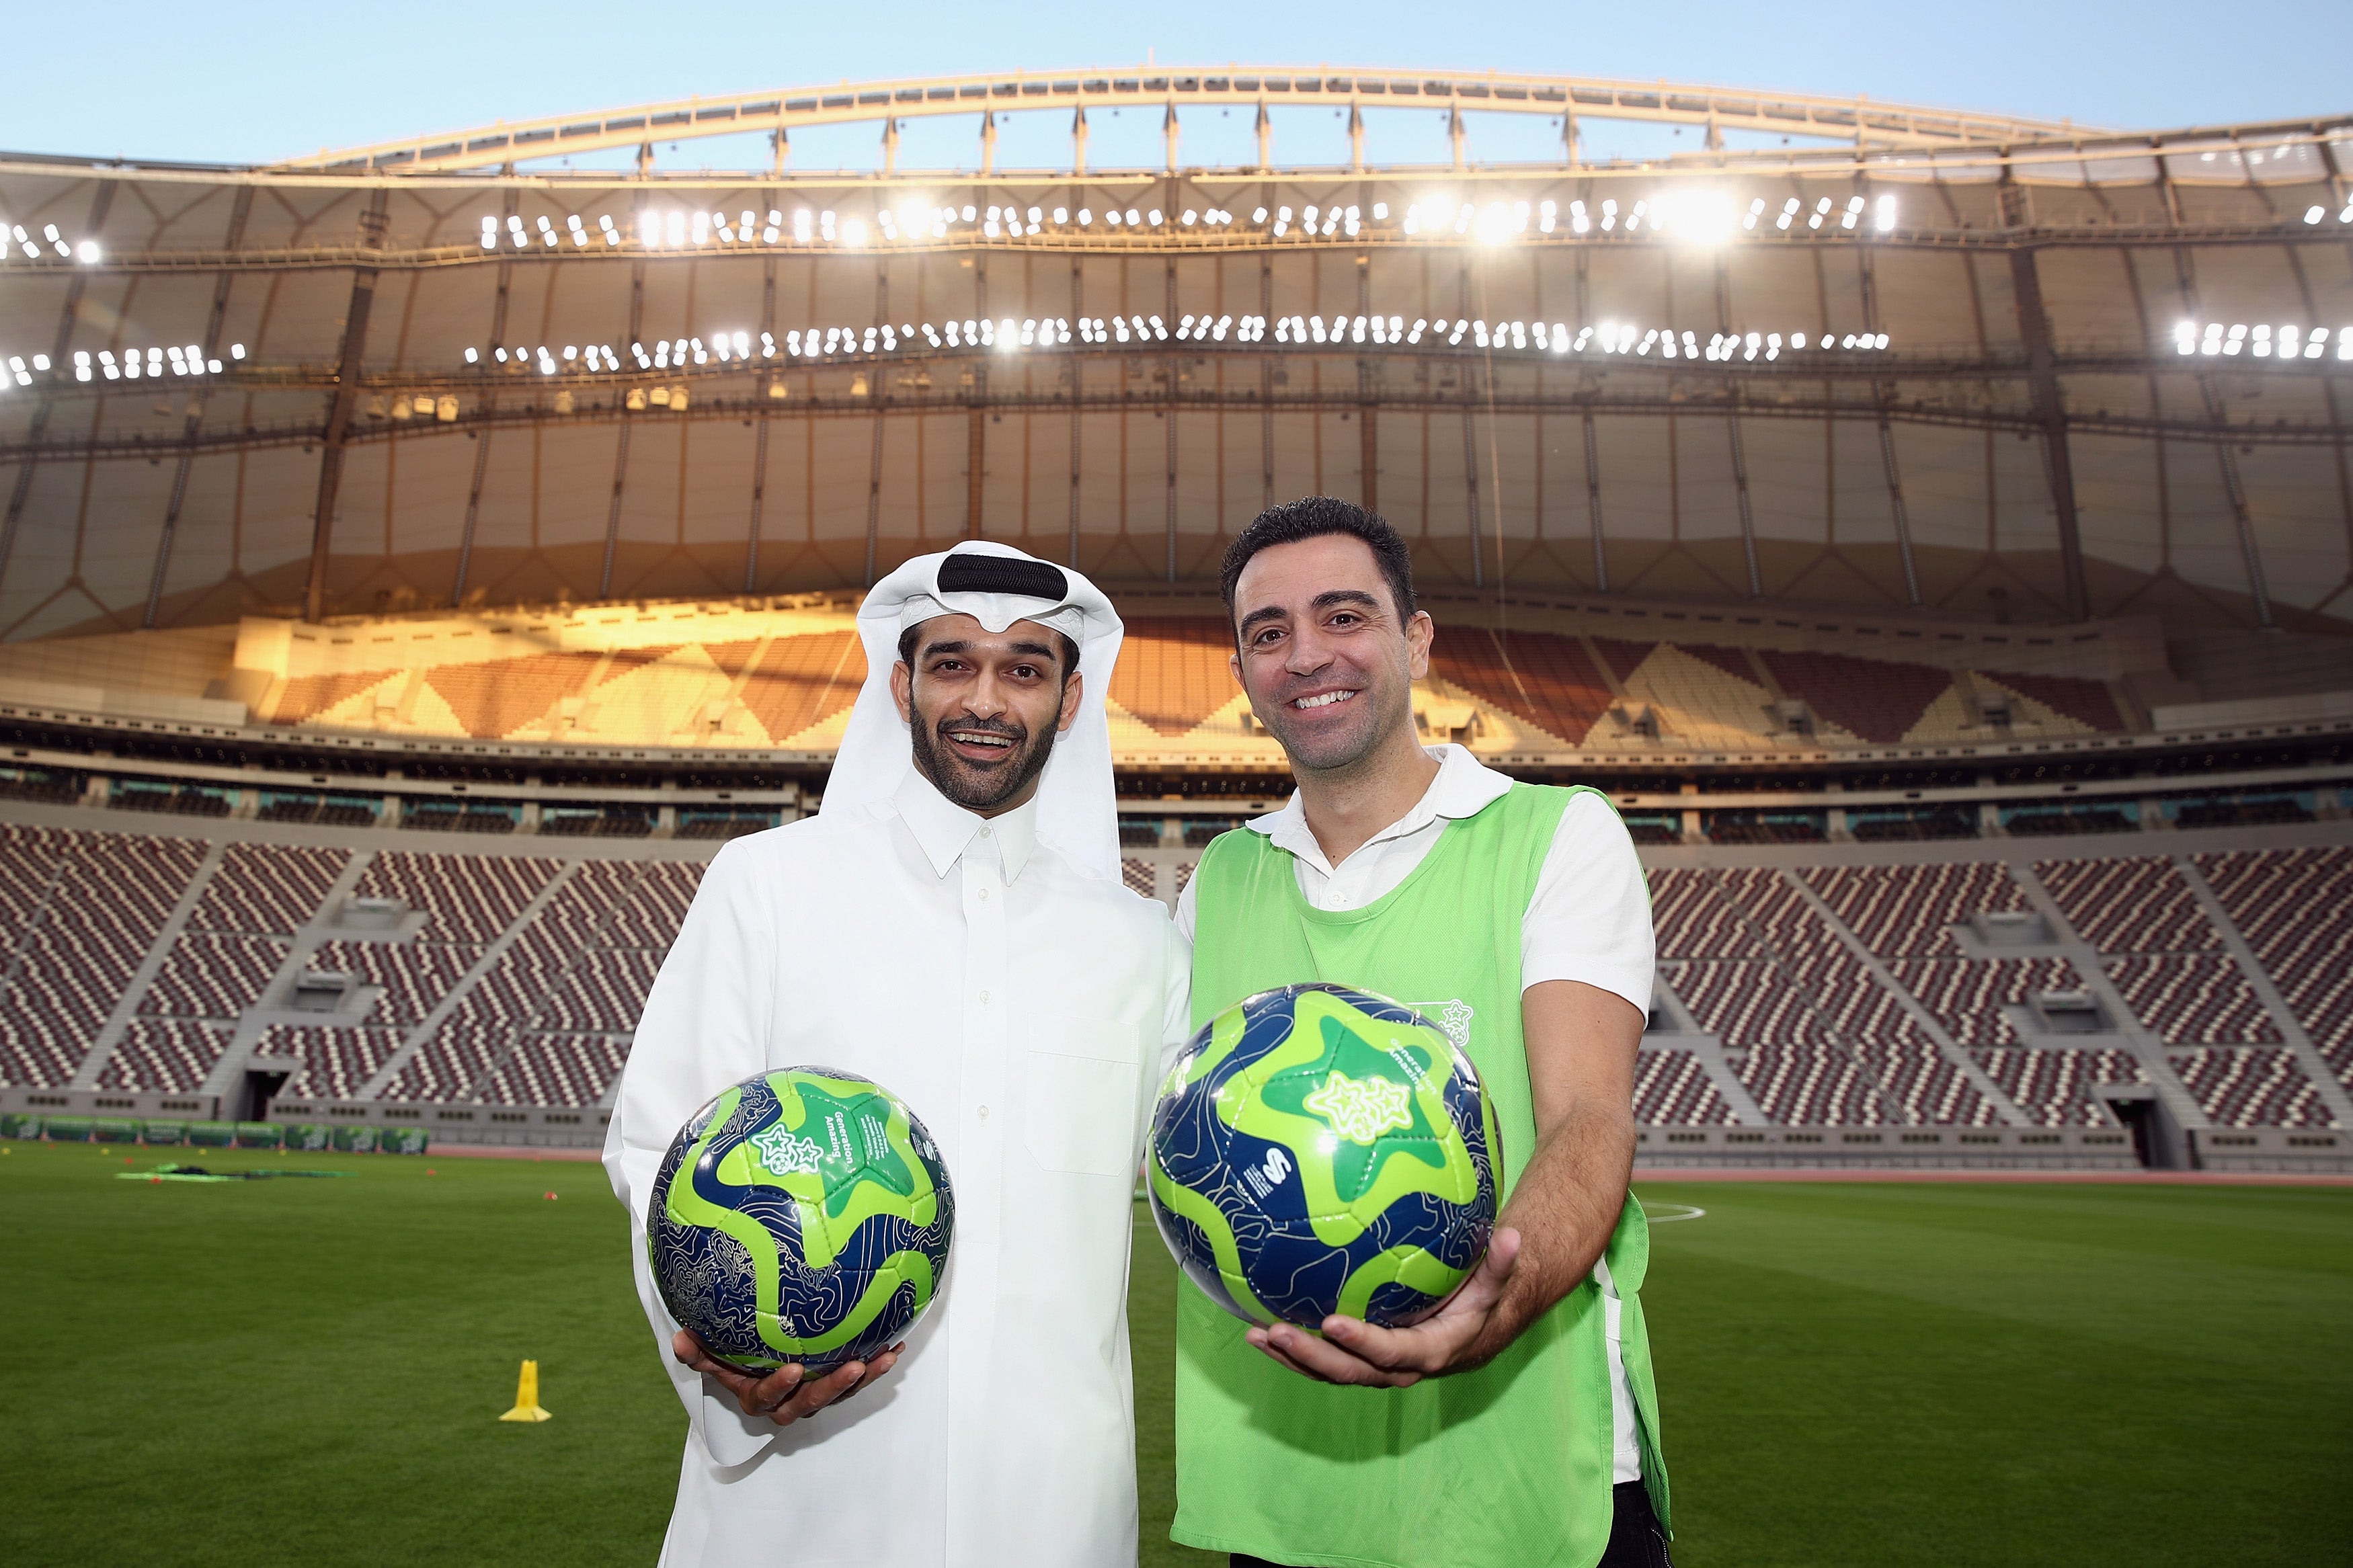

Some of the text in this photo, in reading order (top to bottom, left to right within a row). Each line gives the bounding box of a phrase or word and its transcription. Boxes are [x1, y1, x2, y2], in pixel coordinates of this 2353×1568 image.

[1386, 1047, 1425, 1091] Amazing
[1390, 1038, 1437, 1095] Generation
[824, 1116, 841, 1157] Amazing
[834, 1111, 853, 1164] Generation
